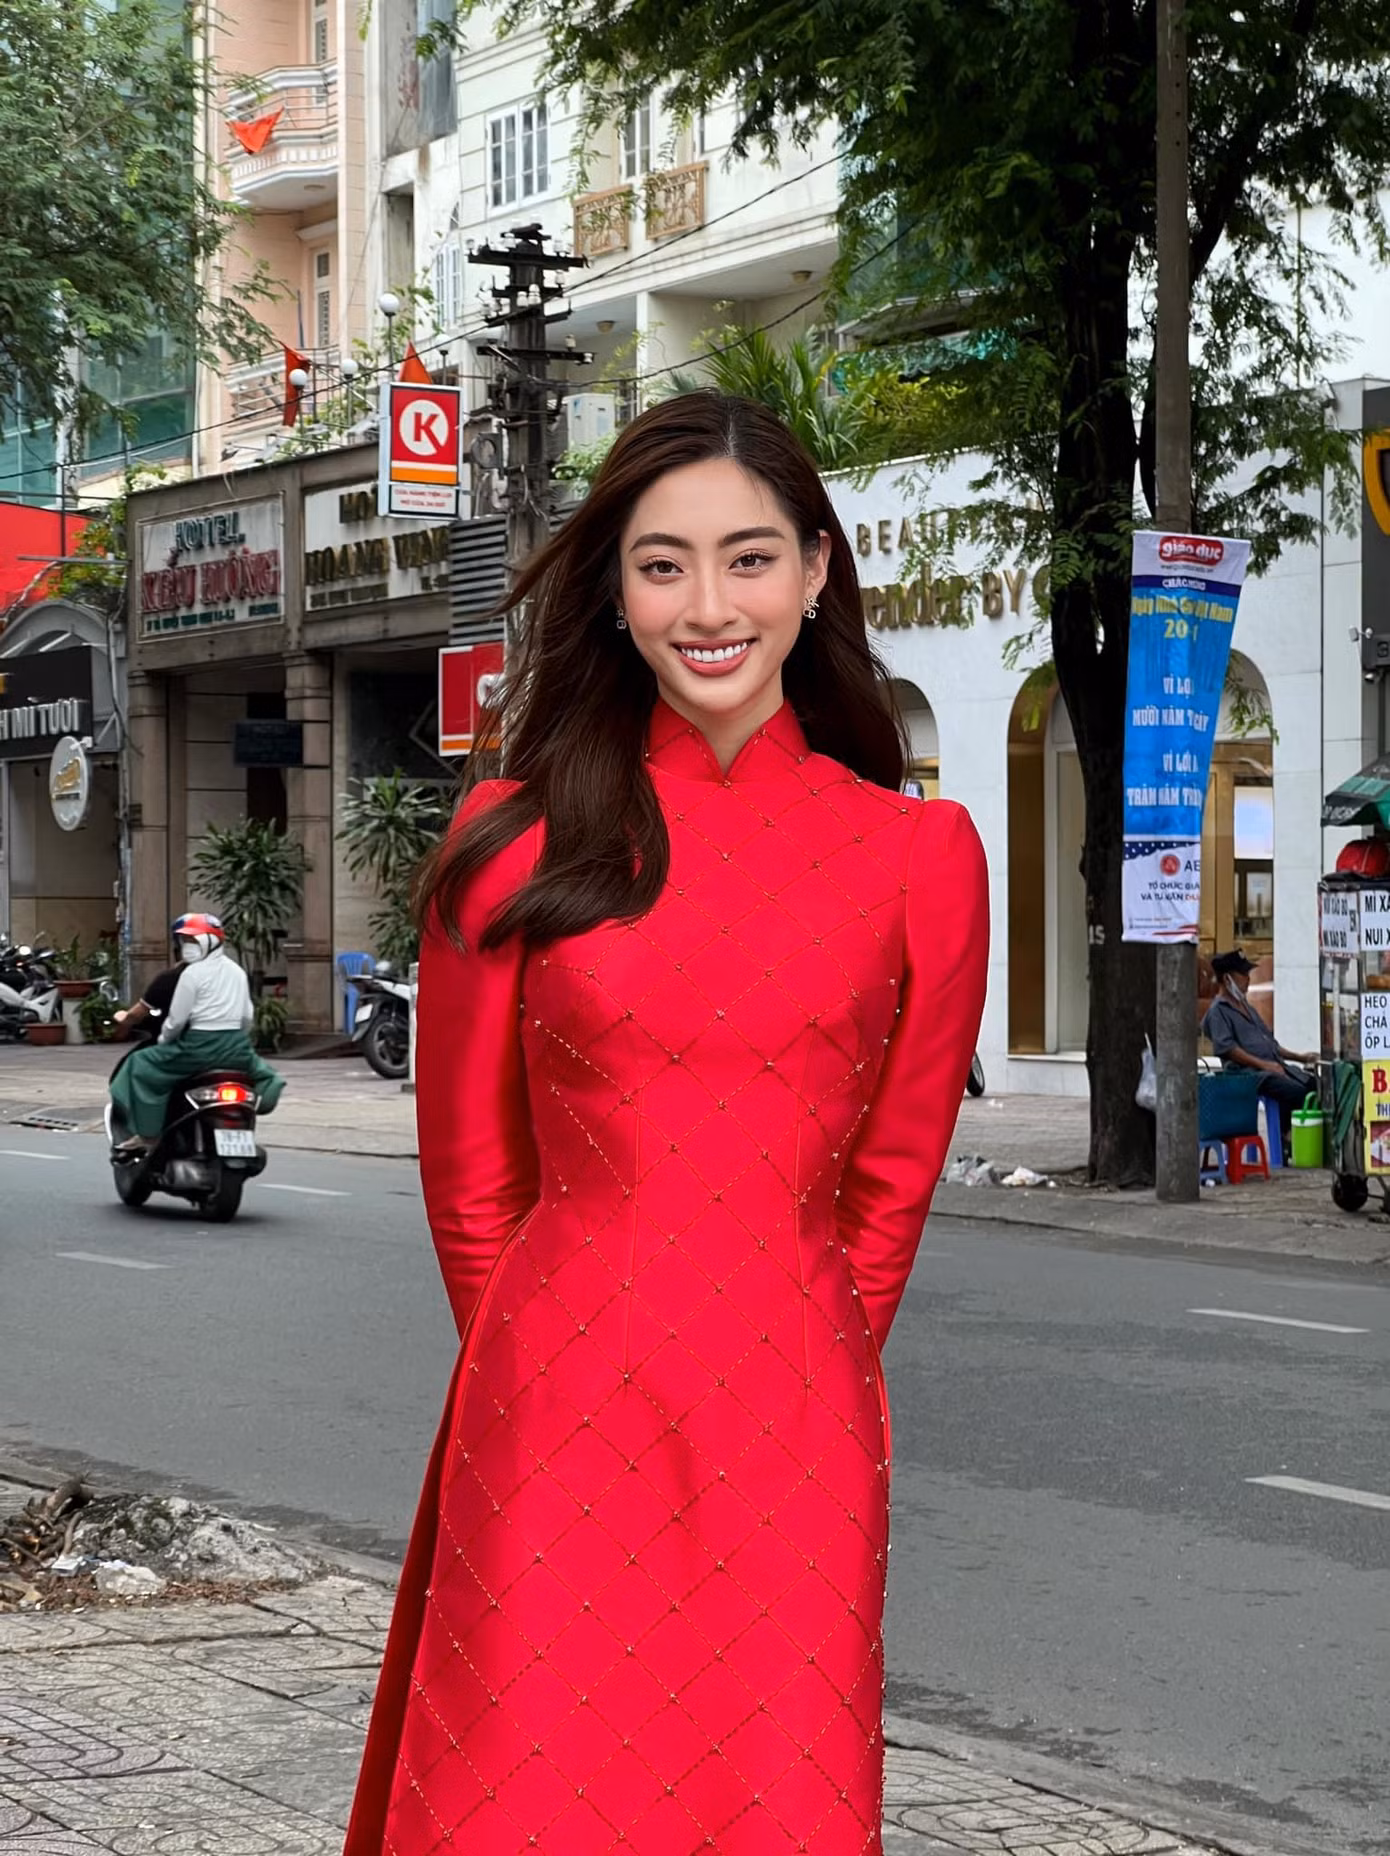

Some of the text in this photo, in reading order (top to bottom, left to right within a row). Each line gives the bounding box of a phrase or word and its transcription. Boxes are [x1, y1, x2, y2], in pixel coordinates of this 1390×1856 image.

[981, 569, 1026, 619] BY
[1365, 927, 1383, 946] NUI
[1364, 995, 1388, 1009] HEO
